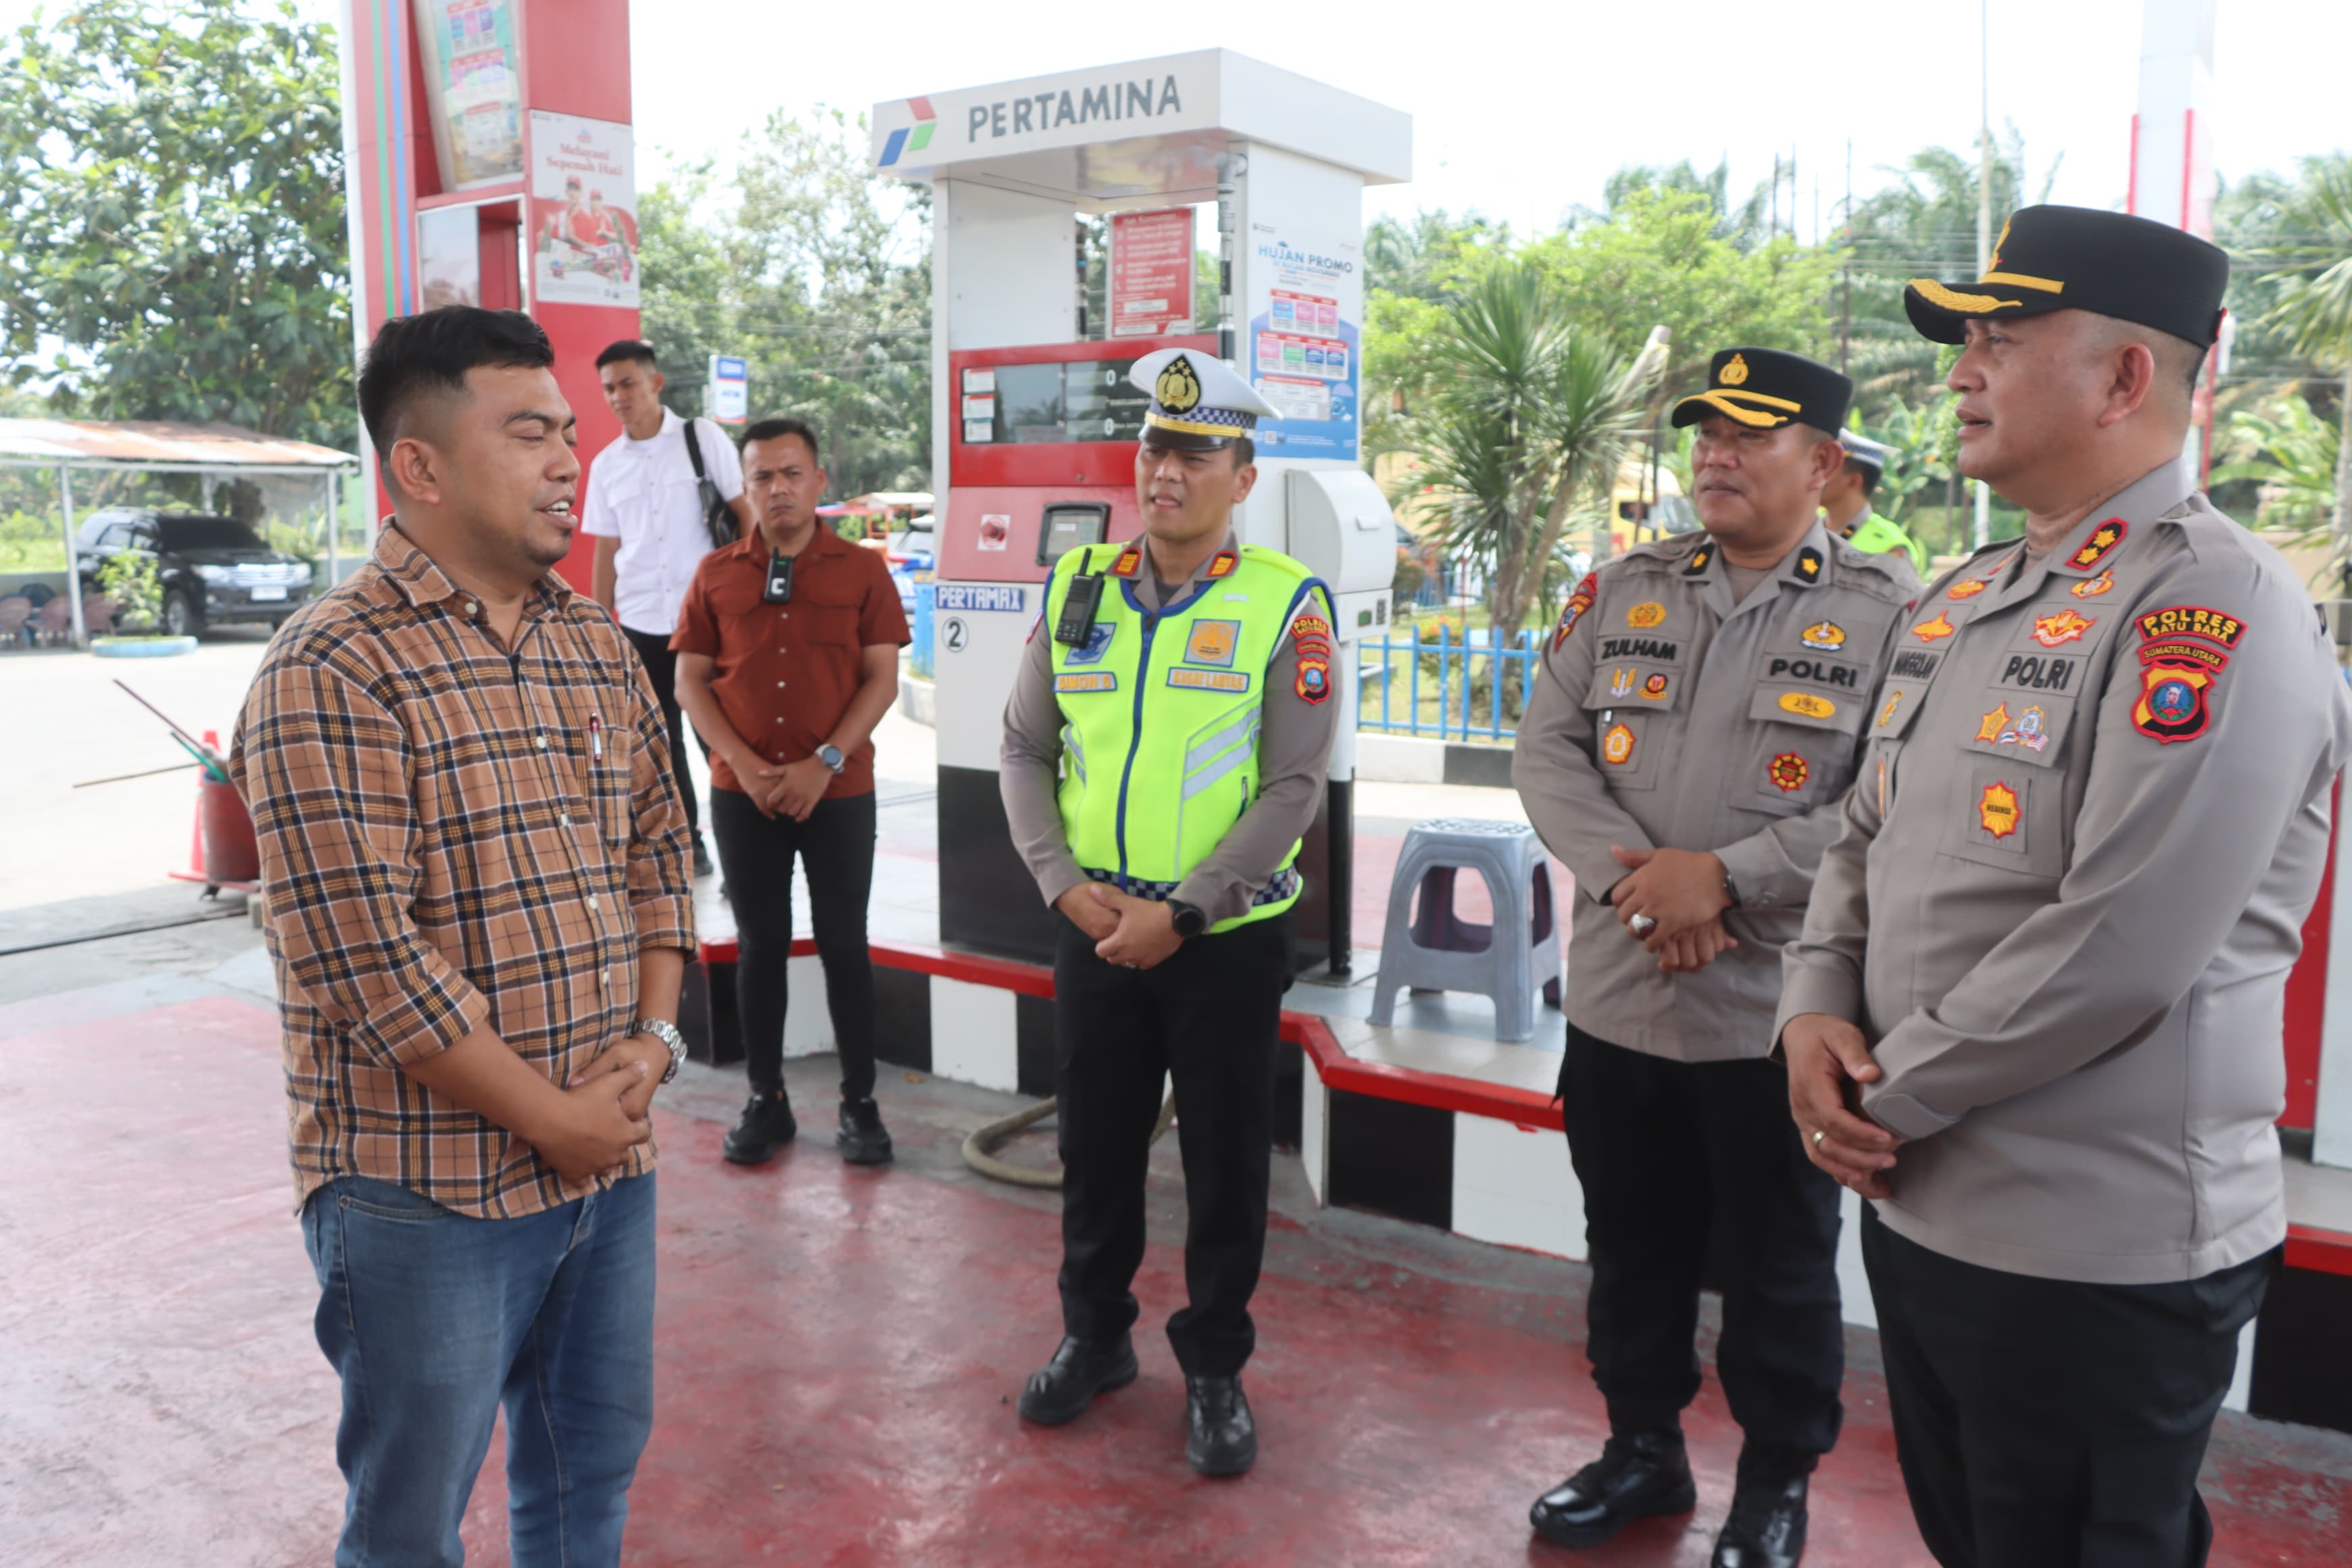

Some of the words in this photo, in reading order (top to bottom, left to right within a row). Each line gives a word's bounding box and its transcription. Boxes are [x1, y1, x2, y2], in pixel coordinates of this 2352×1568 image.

[968, 74, 1181, 143] PERTAMINA
[1258, 243, 1305, 264] HUJAN
[1308, 253, 1354, 273] PROMO
[937, 587, 1021, 610] PERTAMAX
[948, 620, 961, 647] 2
[2143, 609, 2238, 634] POLRES
[2150, 622, 2186, 636] BATU
[2192, 622, 2228, 642] BARA
[1601, 639, 1677, 660] ZULHAM
[2144, 645, 2190, 658] SUMATERA
[2192, 649, 2222, 666] UTARA
[1769, 658, 1858, 688] POLRI
[2001, 656, 2075, 691] POLRI
